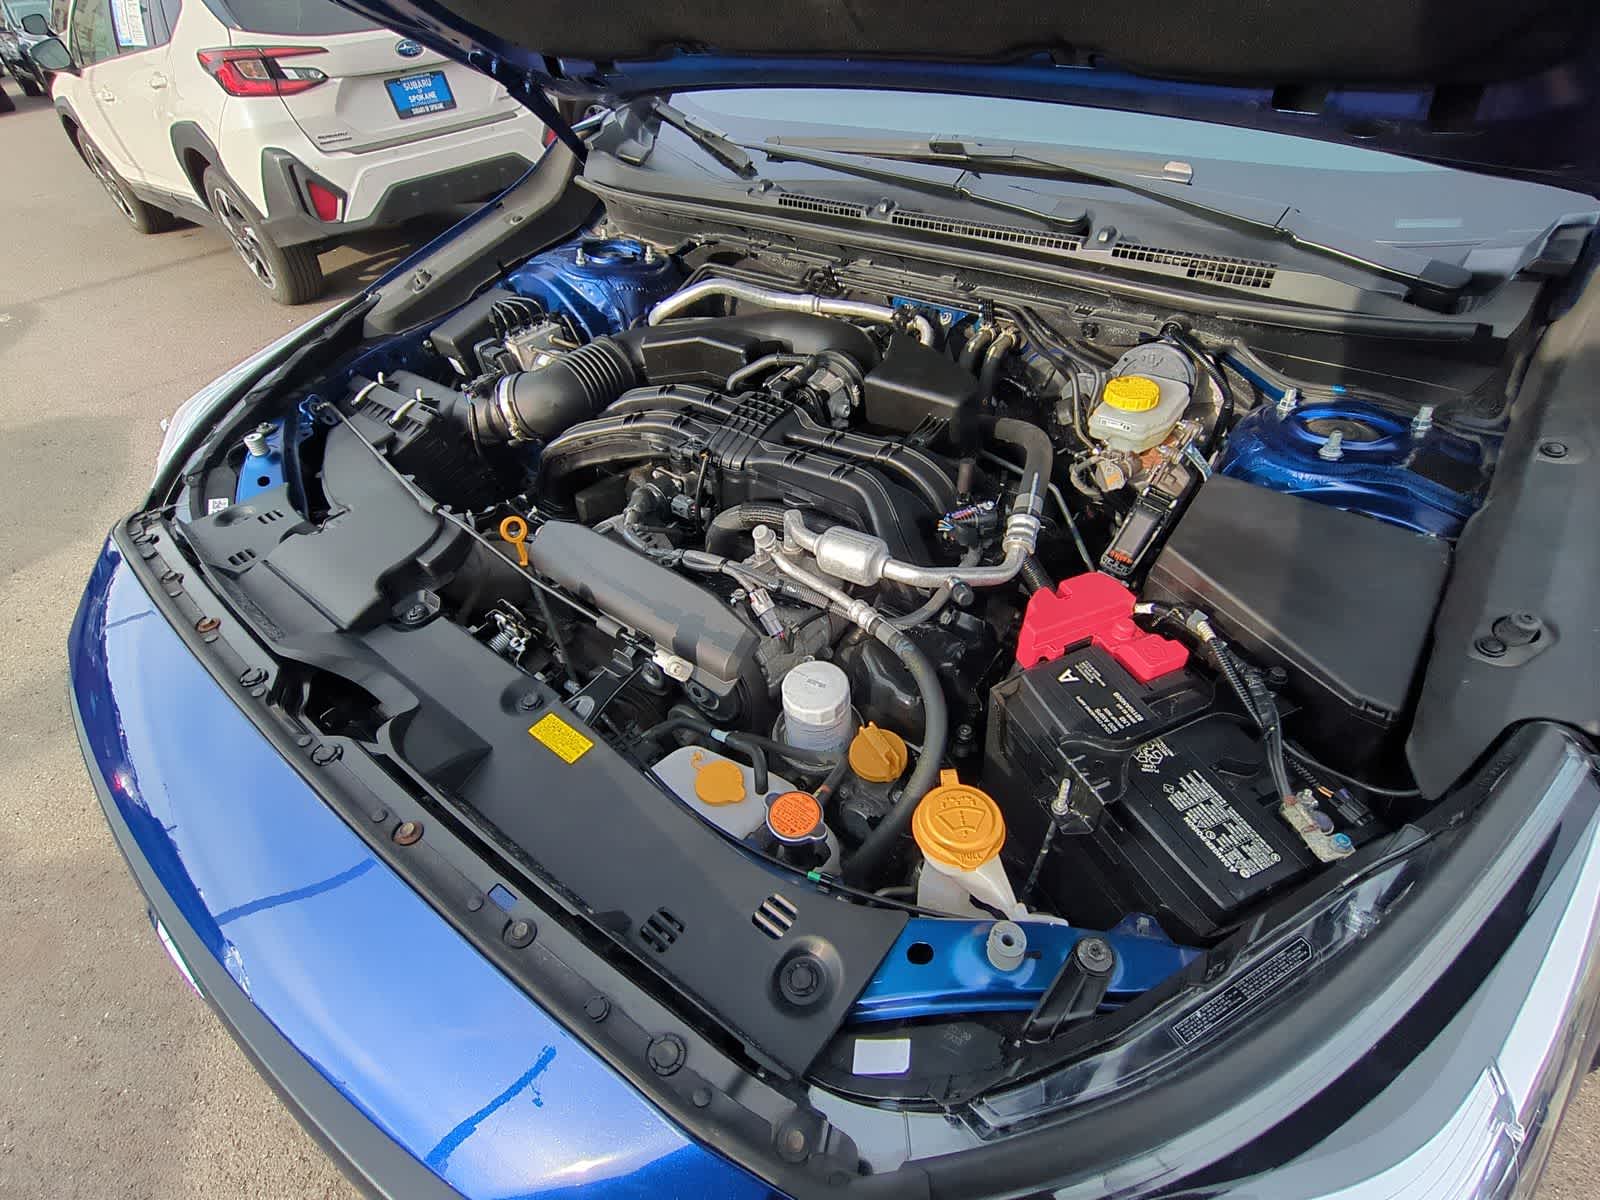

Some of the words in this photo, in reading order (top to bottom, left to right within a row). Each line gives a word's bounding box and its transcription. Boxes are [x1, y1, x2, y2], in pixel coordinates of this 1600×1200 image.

[403, 78, 432, 91] SUBARU
[408, 91, 438, 103] SPOKANE
[1058, 668, 1080, 683] A
